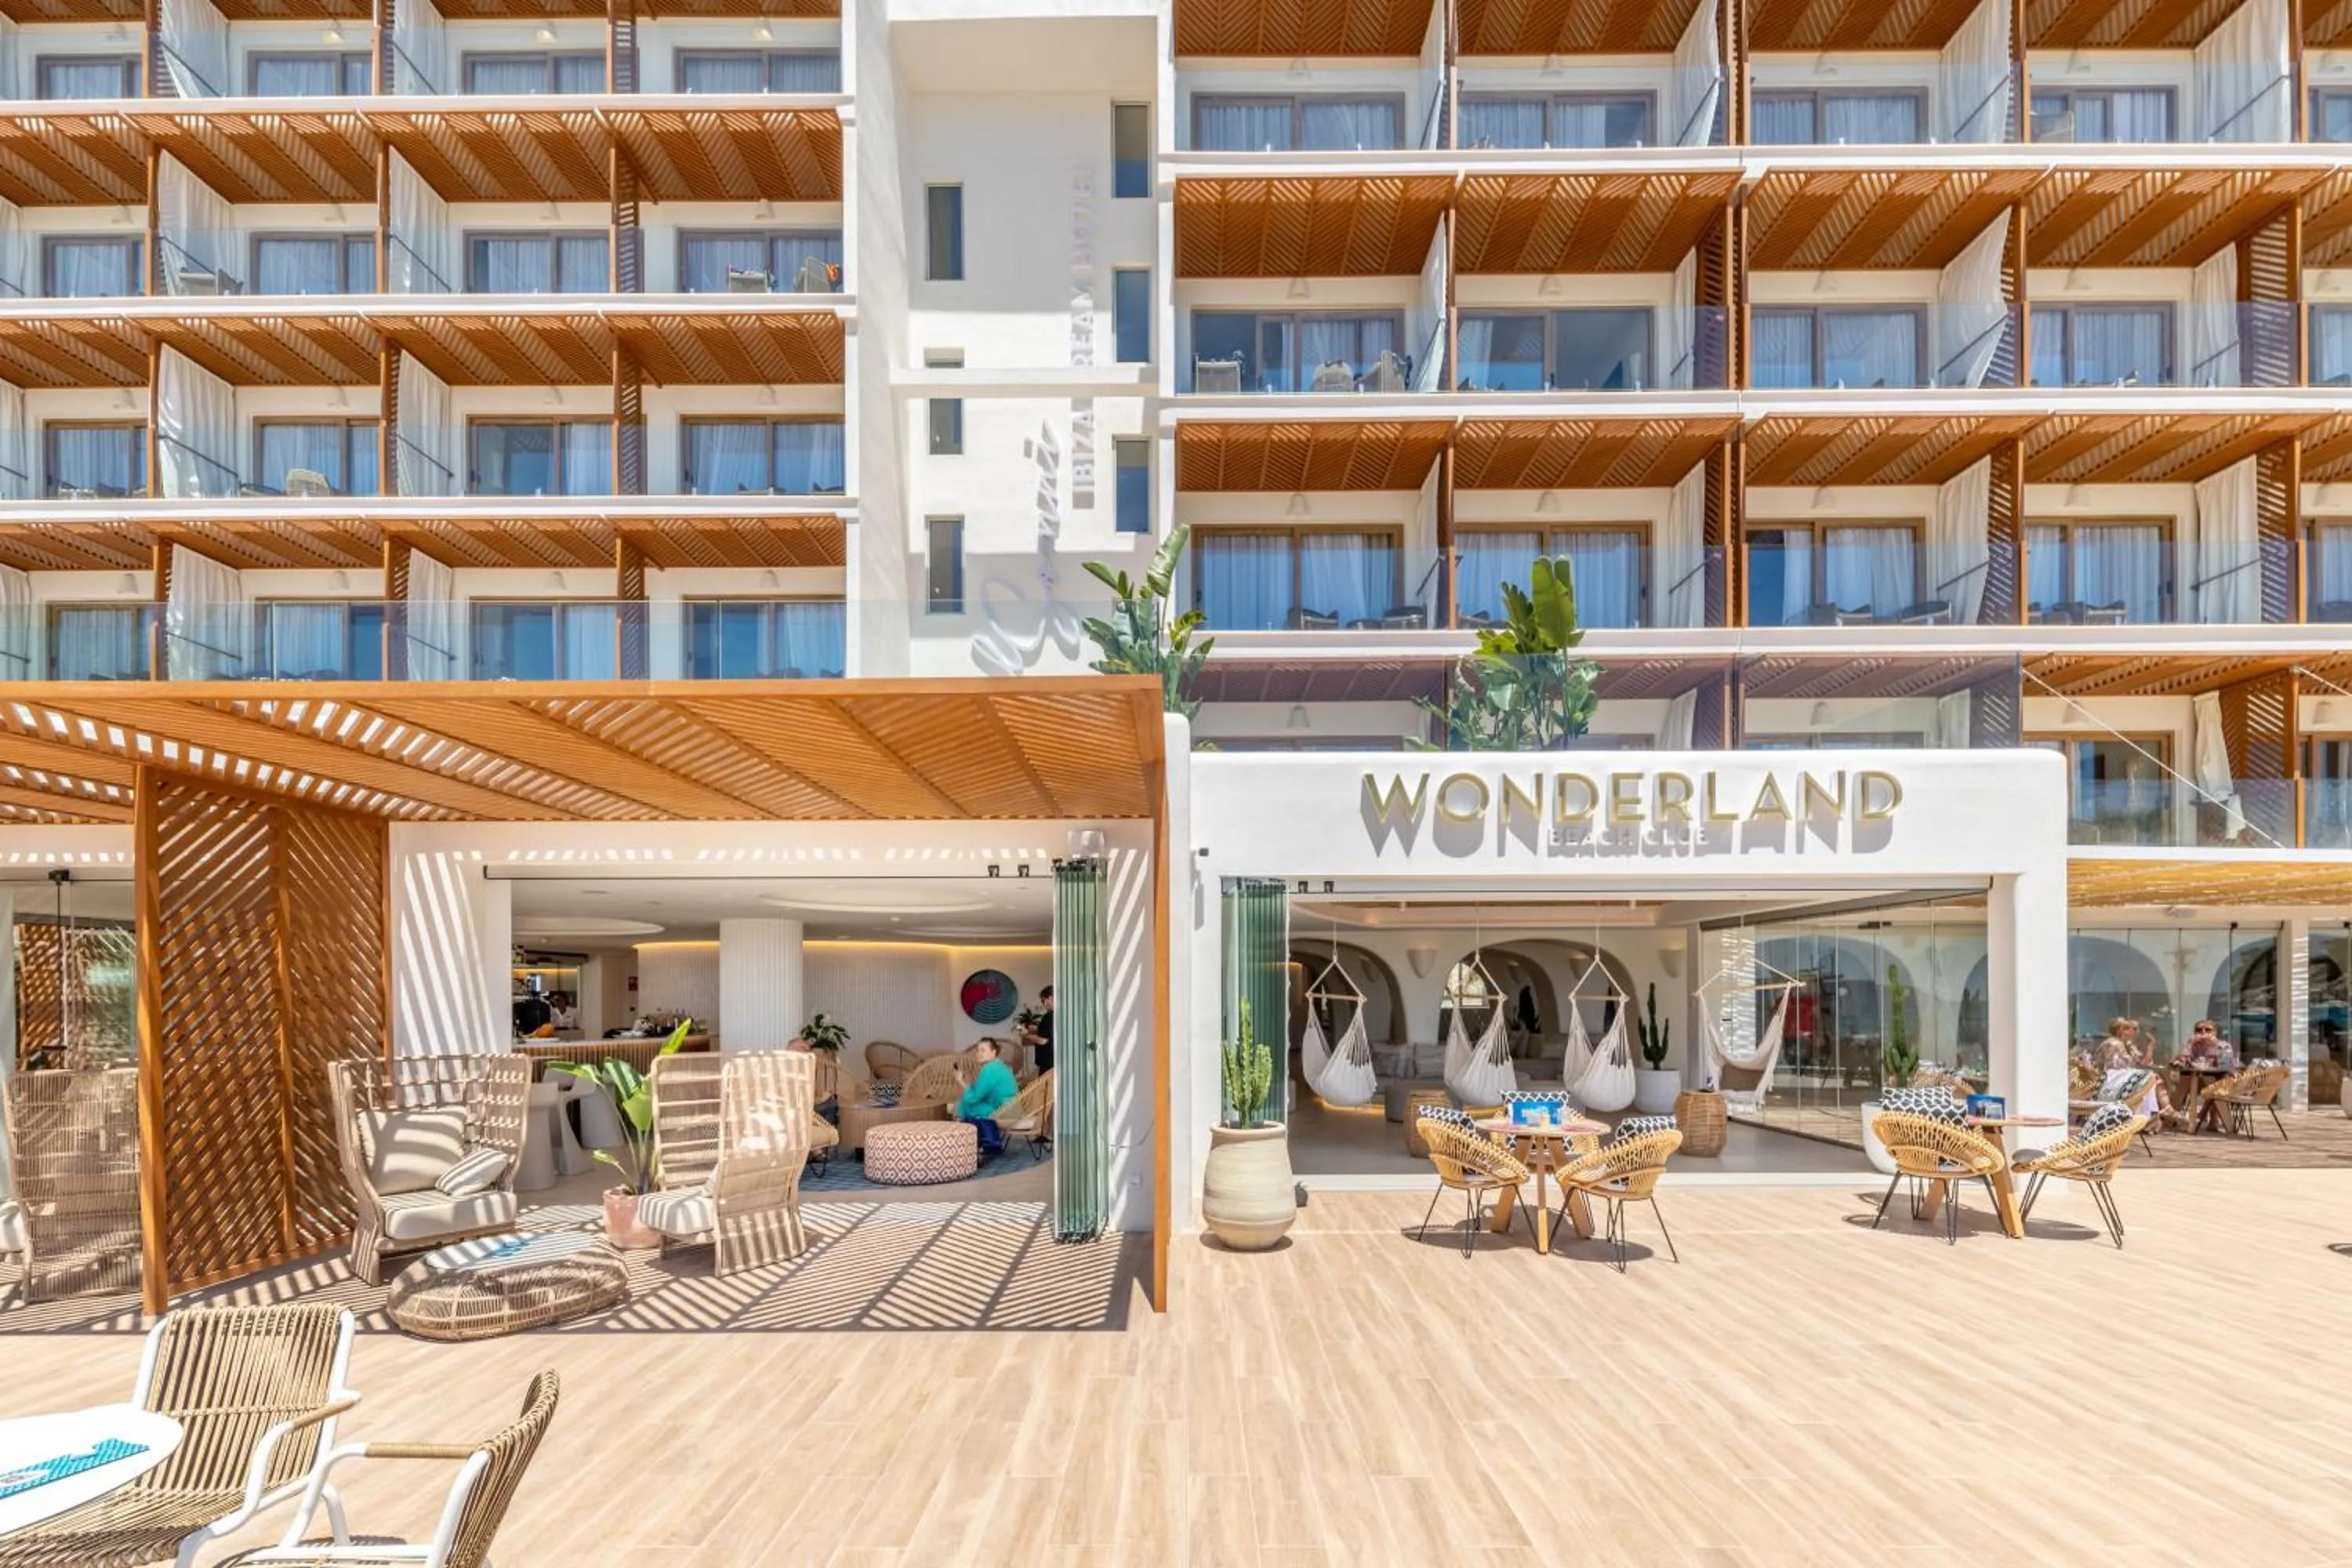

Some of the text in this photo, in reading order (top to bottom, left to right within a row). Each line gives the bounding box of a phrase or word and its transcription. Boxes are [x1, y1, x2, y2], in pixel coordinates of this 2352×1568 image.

[1070, 280, 1094, 367] REAM
[1071, 411, 1094, 492] IBIZA
[1363, 770, 1904, 824] WONDERLAND
[1548, 828, 1634, 846] BEACH
